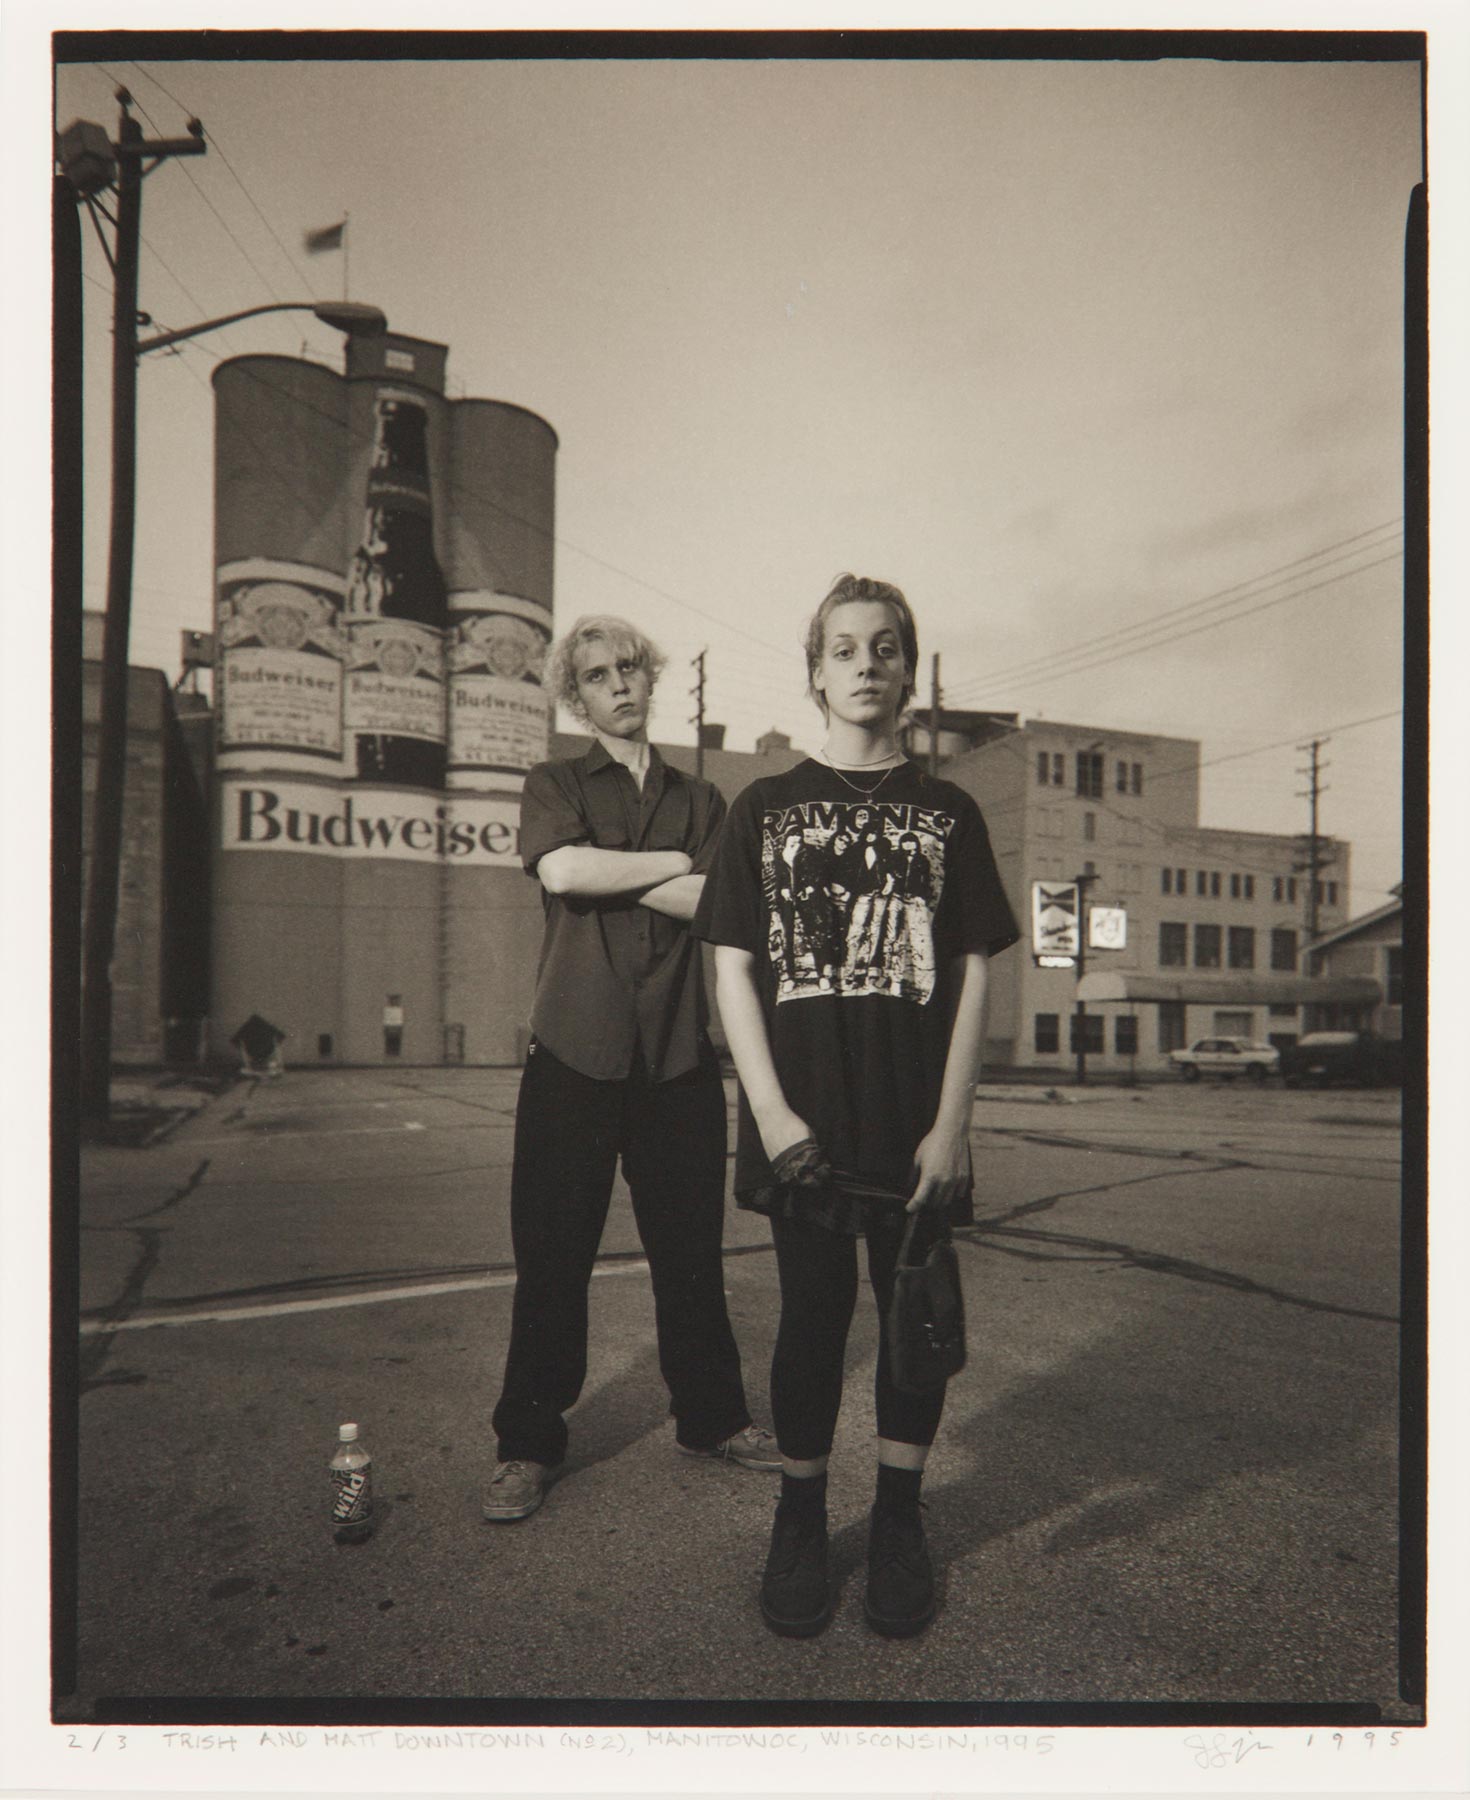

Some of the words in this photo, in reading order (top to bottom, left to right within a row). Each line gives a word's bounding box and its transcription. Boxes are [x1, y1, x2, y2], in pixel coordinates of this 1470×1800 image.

[333, 1473, 366, 1518] Wild
[163, 1732, 237, 1752] TRISH
[259, 1731, 306, 1747] AND
[324, 1731, 382, 1747] MATT
[394, 1731, 544, 1750] DOWNTOWN
[985, 1734, 1056, 1754] 1995
[1306, 1731, 1403, 1751] 1995
